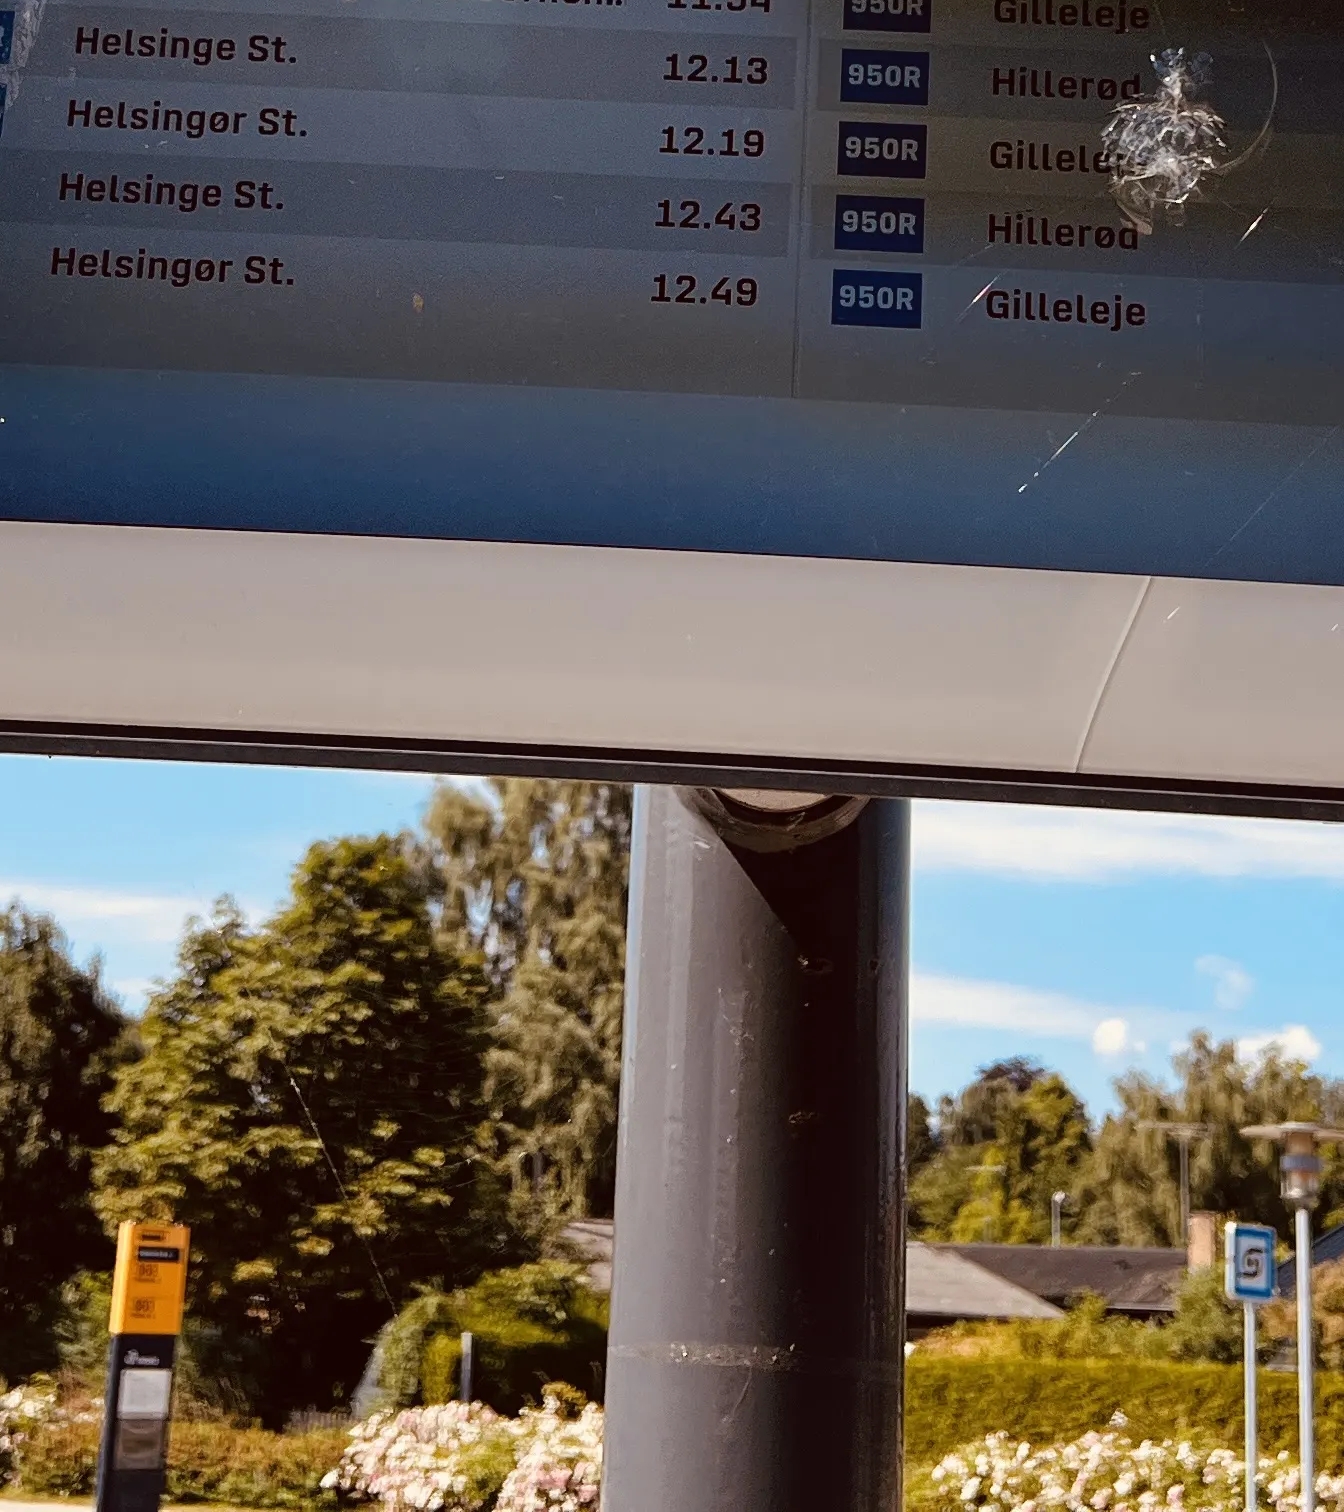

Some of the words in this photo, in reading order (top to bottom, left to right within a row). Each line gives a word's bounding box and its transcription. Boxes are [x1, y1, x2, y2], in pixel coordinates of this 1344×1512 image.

[74, 27, 237, 66] Helsinge
[247, 35, 298, 65] St.
[661, 53, 769, 85] 12.13
[847, 64, 922, 88] 950R
[992, 66, 1141, 101] Hillerød
[67, 100, 249, 138] Helsingør
[257, 108, 308, 137] St.
[658, 126, 766, 158] 12.19
[845, 136, 919, 161] 950R
[58, 173, 223, 212] Helsinge
[233, 181, 285, 210] St.
[654, 200, 762, 232] 12.43
[842, 211, 917, 235] 950R
[50, 247, 233, 287] Helsingør
[242, 255, 295, 286] St.
[650, 274, 758, 307] 12.49
[839, 285, 915, 310] 950R
[985, 288, 1147, 331] Gilleleje
